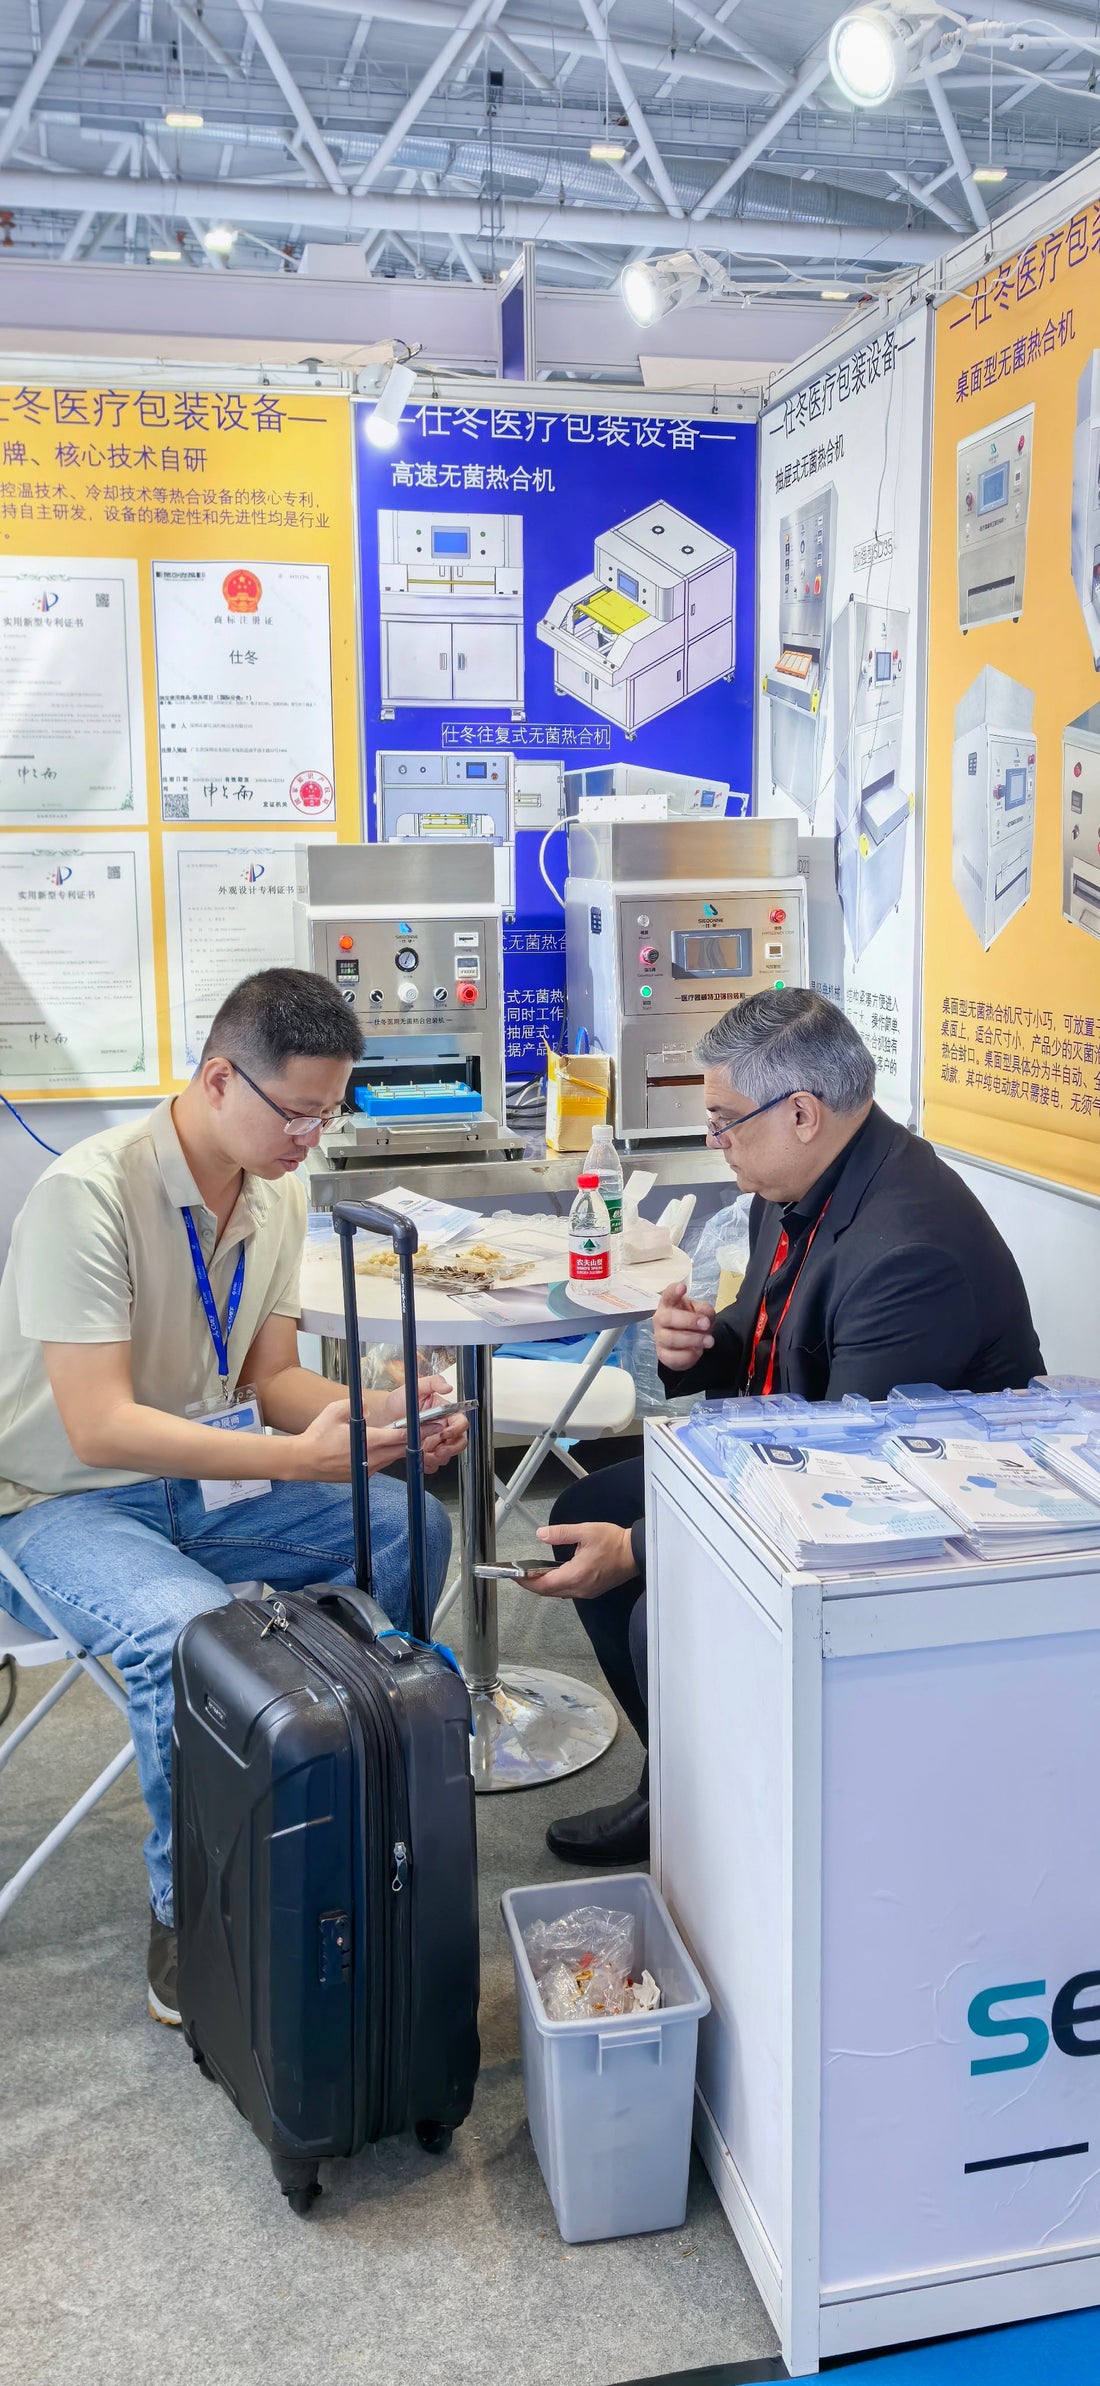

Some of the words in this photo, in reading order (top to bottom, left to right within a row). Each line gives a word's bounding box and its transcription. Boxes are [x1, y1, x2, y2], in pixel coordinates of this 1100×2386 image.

[956, 308, 1076, 403] 桌面型无菌热合机
[2, 441, 208, 473] 牌、核心技术自研
[775, 434, 845, 495] 抽屉式无菌热合机
[390, 461, 555, 492] 高速无菌热合机
[229, 650, 258, 665] 仕冬
[442, 726, 610, 745] 仕冬往复式无菌热合机
[218, 885, 294, 895] 外观设计专利证书
[504, 988, 564, 1004] 式无菌热
[504, 1006, 564, 1022] 同时工作
